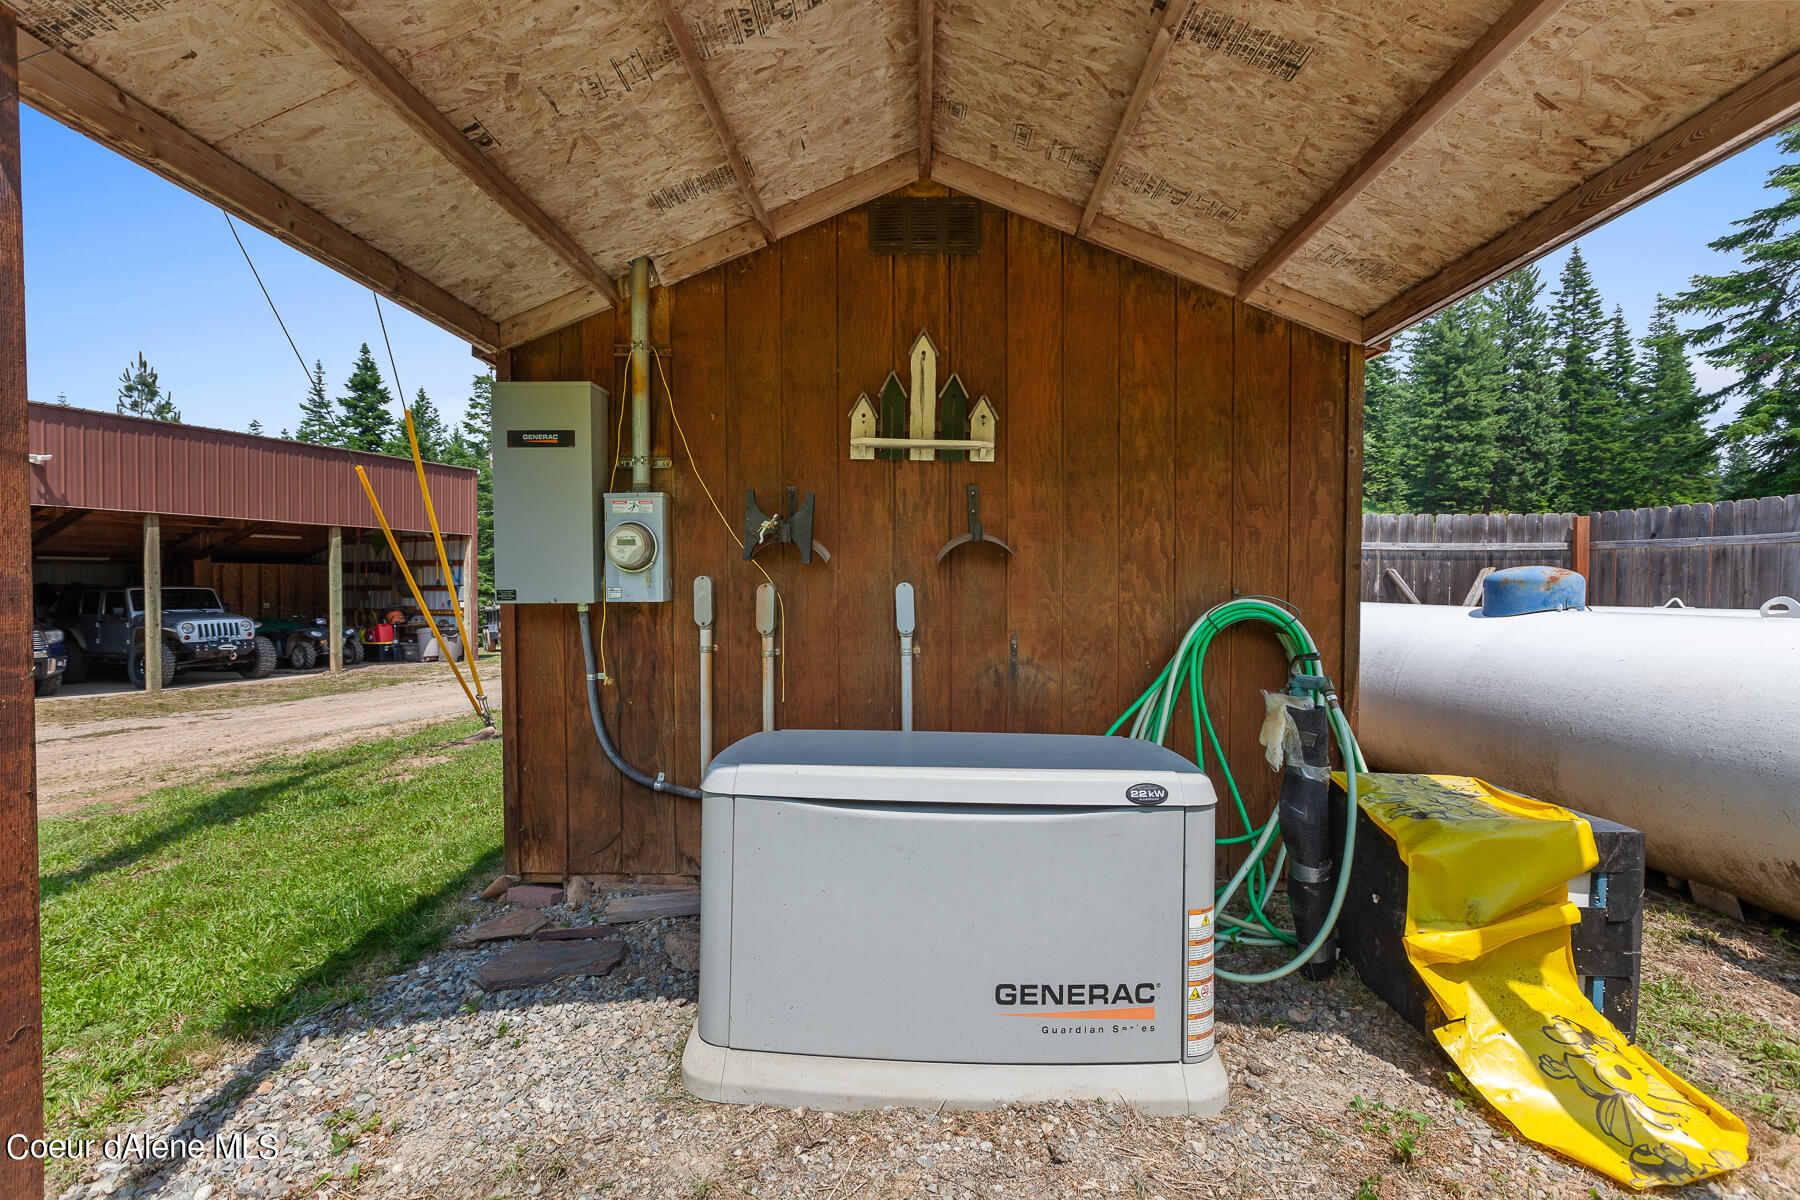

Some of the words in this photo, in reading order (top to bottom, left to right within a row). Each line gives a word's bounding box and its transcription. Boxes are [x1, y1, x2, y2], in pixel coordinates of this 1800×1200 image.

[738, 8, 756, 38] APA
[995, 983, 1155, 1005] GENERAC
[1041, 1026, 1104, 1034] Guardian
